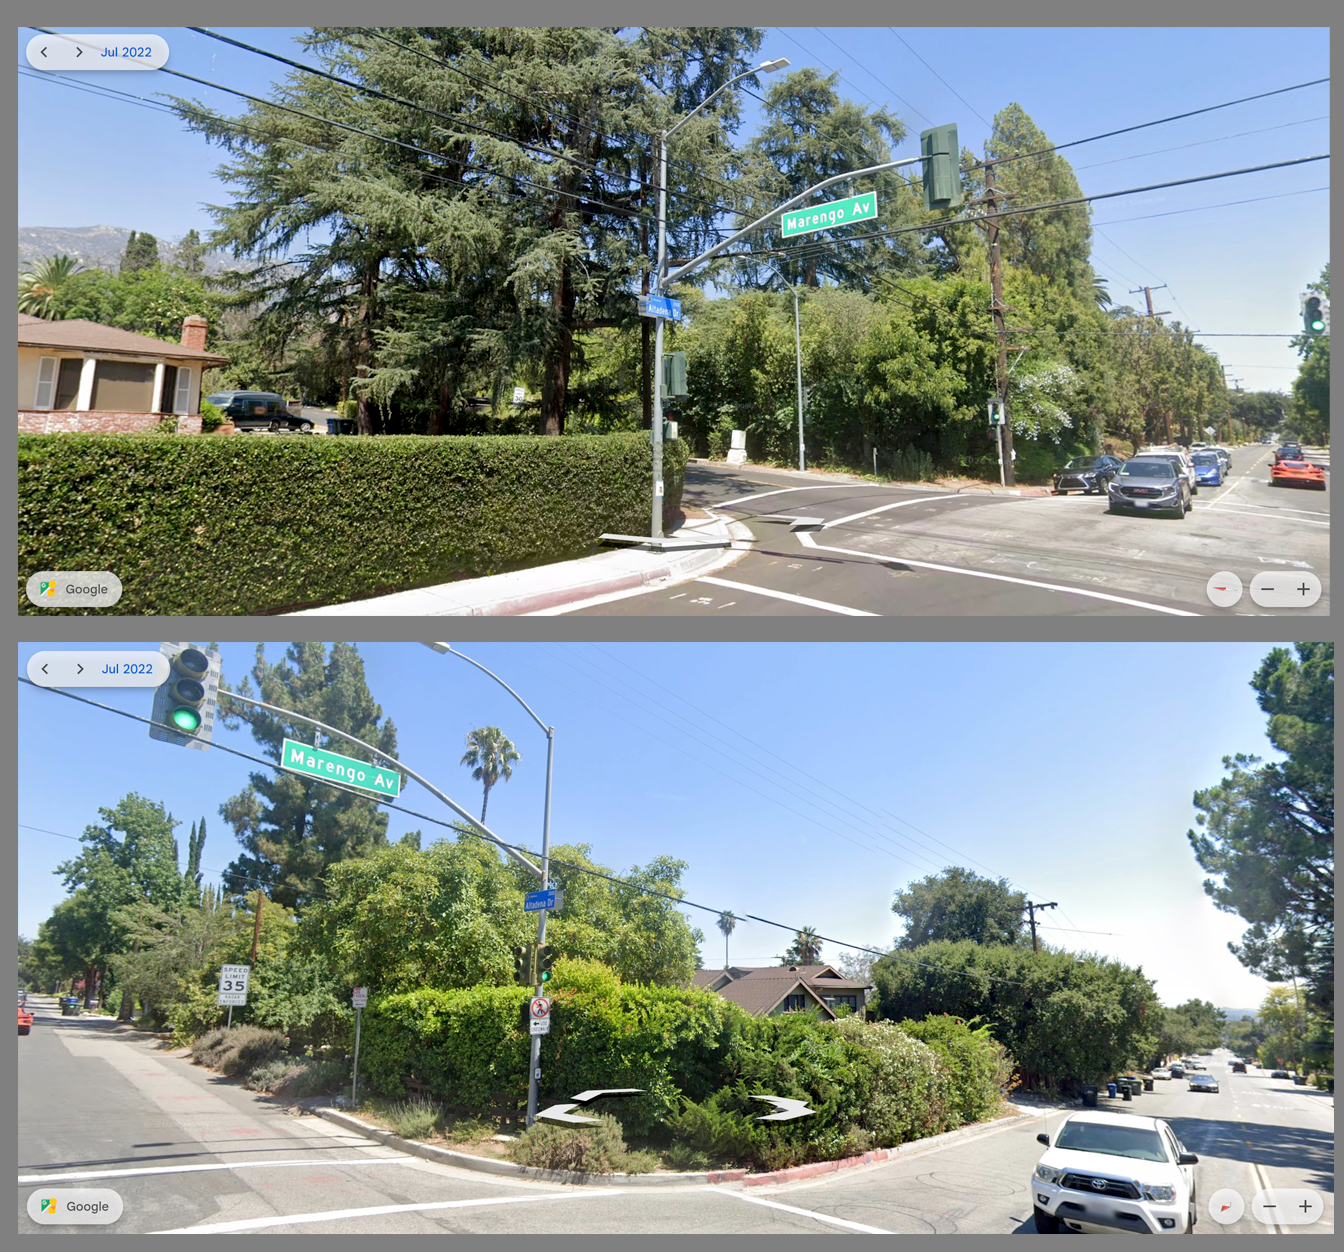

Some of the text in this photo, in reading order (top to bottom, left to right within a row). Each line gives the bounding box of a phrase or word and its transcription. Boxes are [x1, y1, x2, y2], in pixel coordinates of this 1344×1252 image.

[787, 202, 870, 230] Marengo Av
[648, 303, 672, 316] Altadena
[673, 308, 679, 318] Dr
[290, 748, 394, 789] Marengo Av
[526, 898, 554, 910] Altadena Dr
[223, 980, 245, 991] 35
